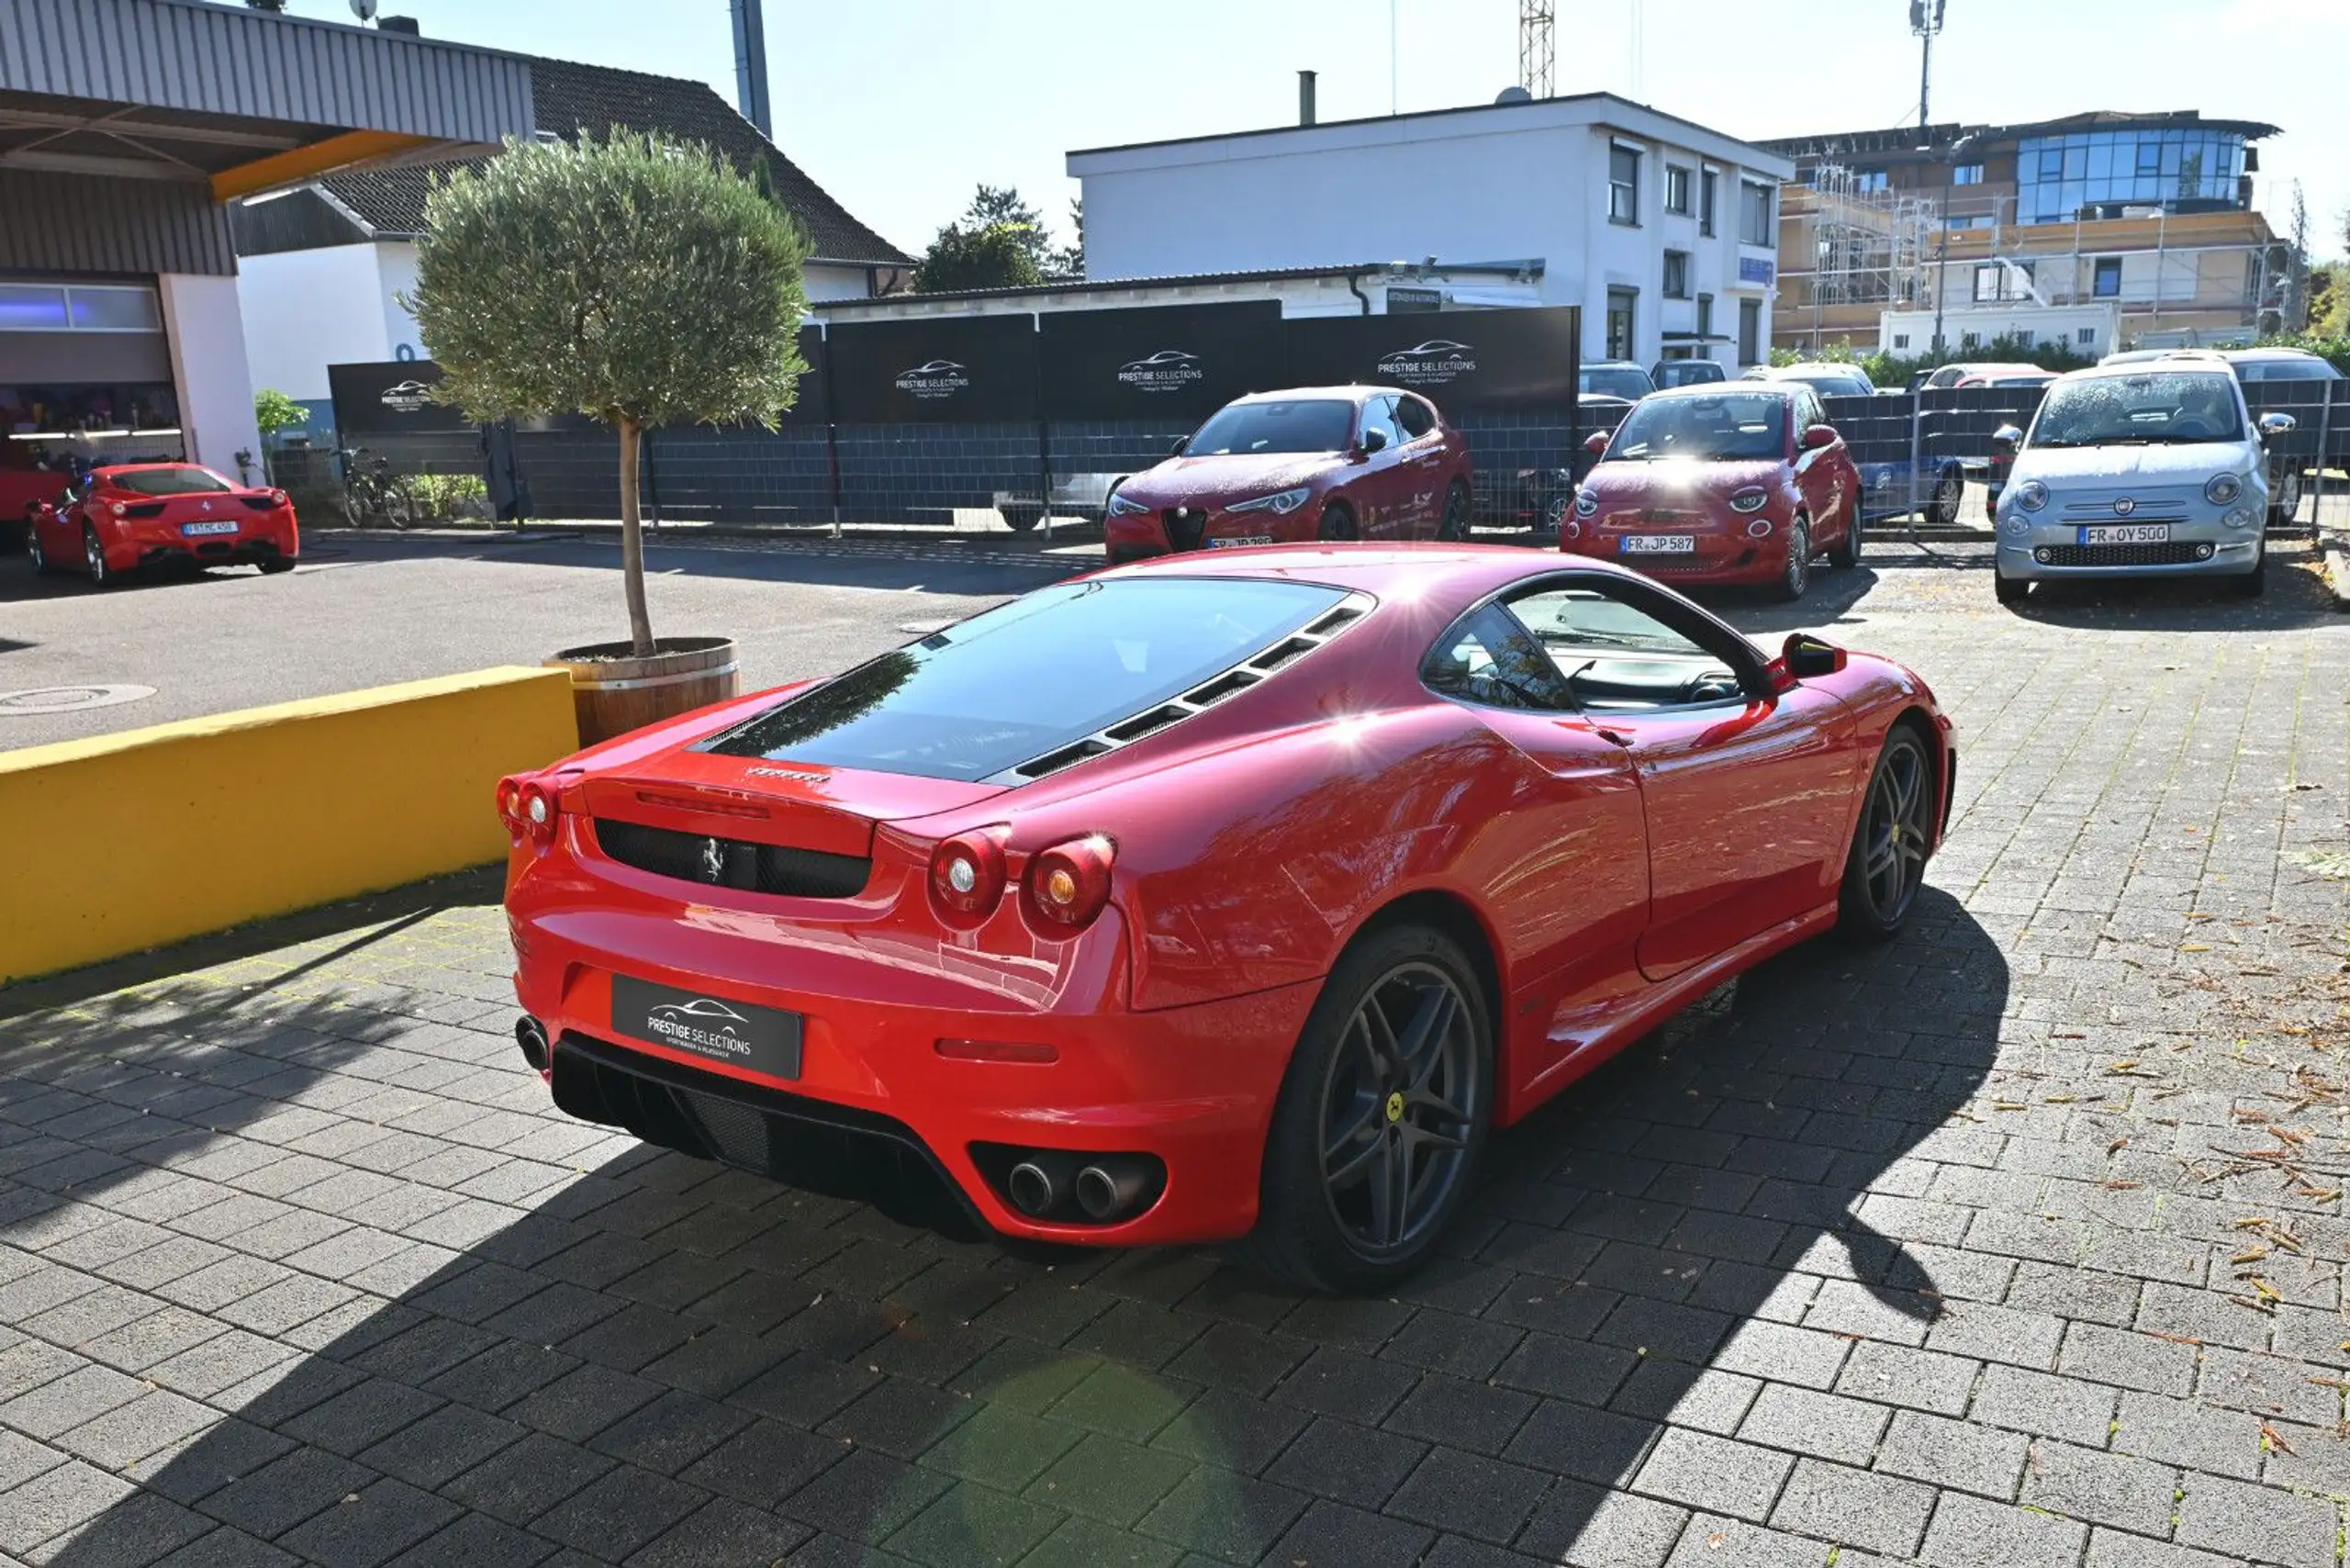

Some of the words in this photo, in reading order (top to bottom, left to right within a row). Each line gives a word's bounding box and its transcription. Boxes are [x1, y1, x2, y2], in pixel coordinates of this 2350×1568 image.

[1377, 363, 1419, 373] PRESTIGE
[1421, 361, 1476, 372] SELECTIONS
[1118, 371, 1154, 381] PRESTIGE
[1155, 369, 1203, 380] SELECTIONS
[895, 379, 926, 389] PRESTIGE
[2087, 528, 2107, 543] FR
[2116, 527, 2135, 542] OY
[2138, 526, 2165, 541] 500
[1628, 537, 1643, 550] FR
[1651, 537, 1667, 550] JP
[1670, 537, 1693, 551] 587
[647, 1016, 690, 1040] PRESTIGE
[691, 1028, 751, 1056] SELECTIONS
